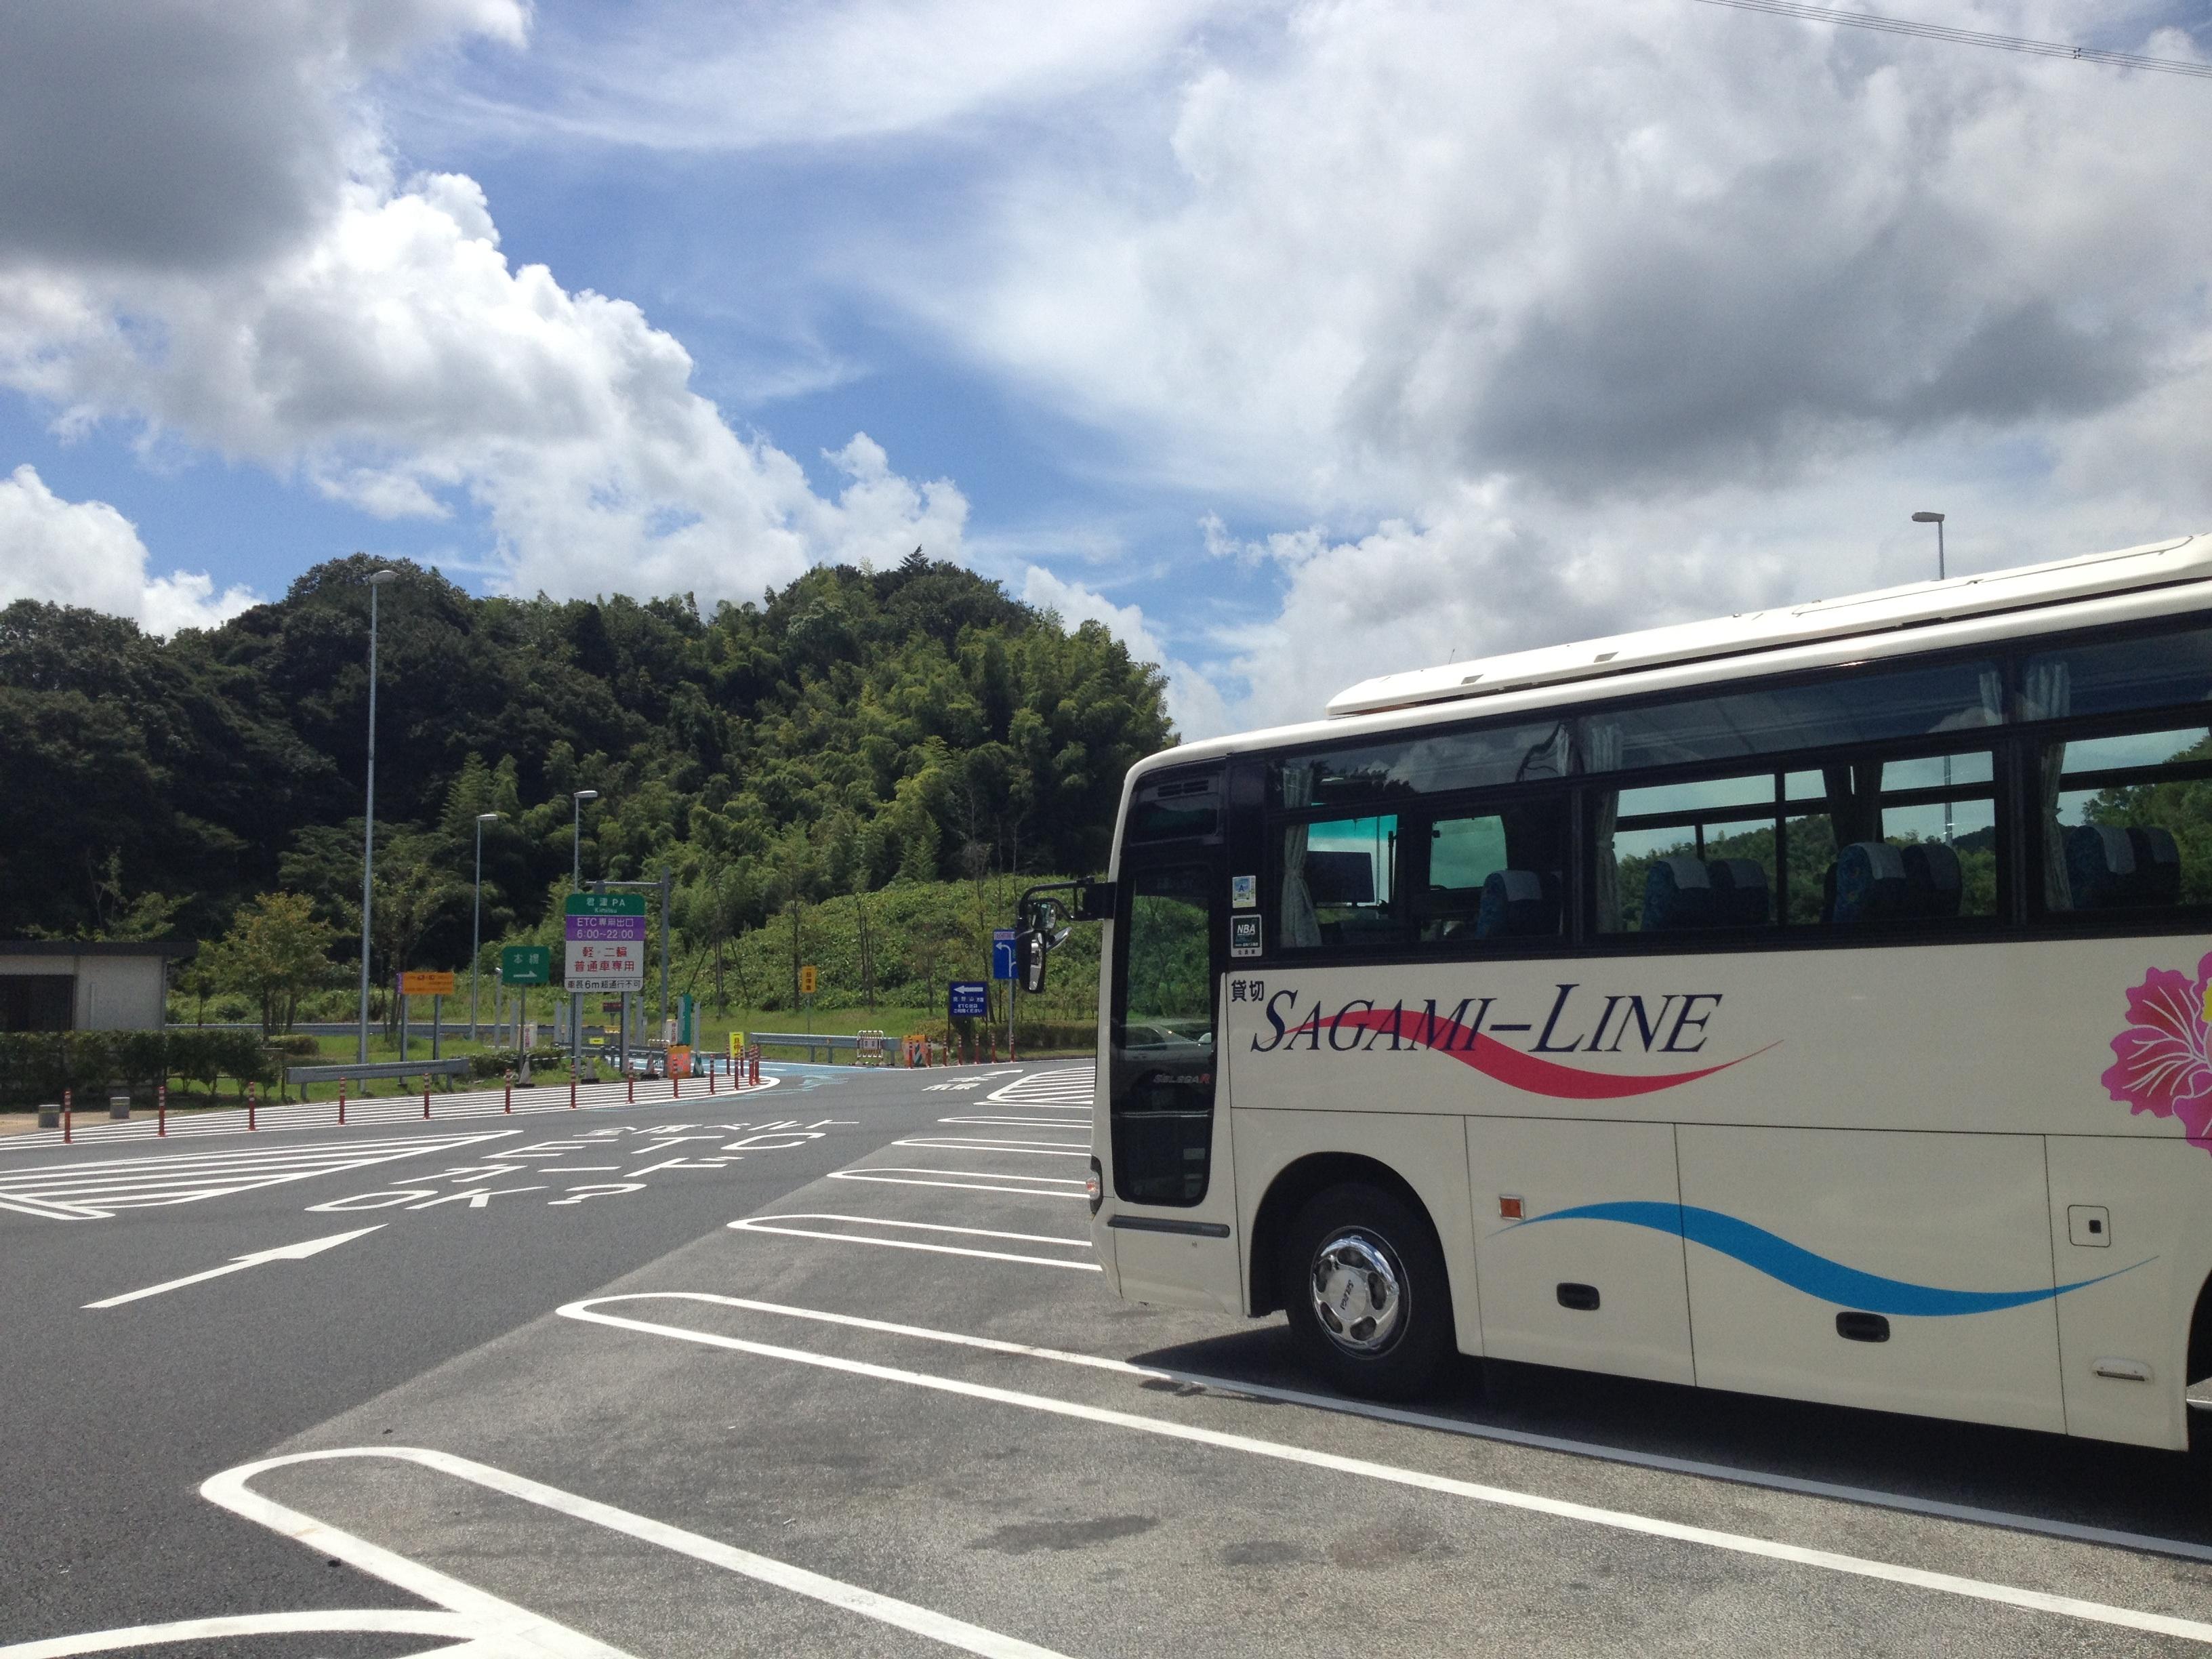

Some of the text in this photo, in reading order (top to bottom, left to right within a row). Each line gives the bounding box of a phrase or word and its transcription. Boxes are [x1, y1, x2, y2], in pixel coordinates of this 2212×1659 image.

[612, 899, 626, 907] PA
[1237, 924, 1256, 934] NBA
[574, 960, 634, 972] 普通車専用
[1231, 979, 1265, 1003] 貸切
[480, 1132, 826, 1160] ETC
[389, 1155, 746, 1185] カード
